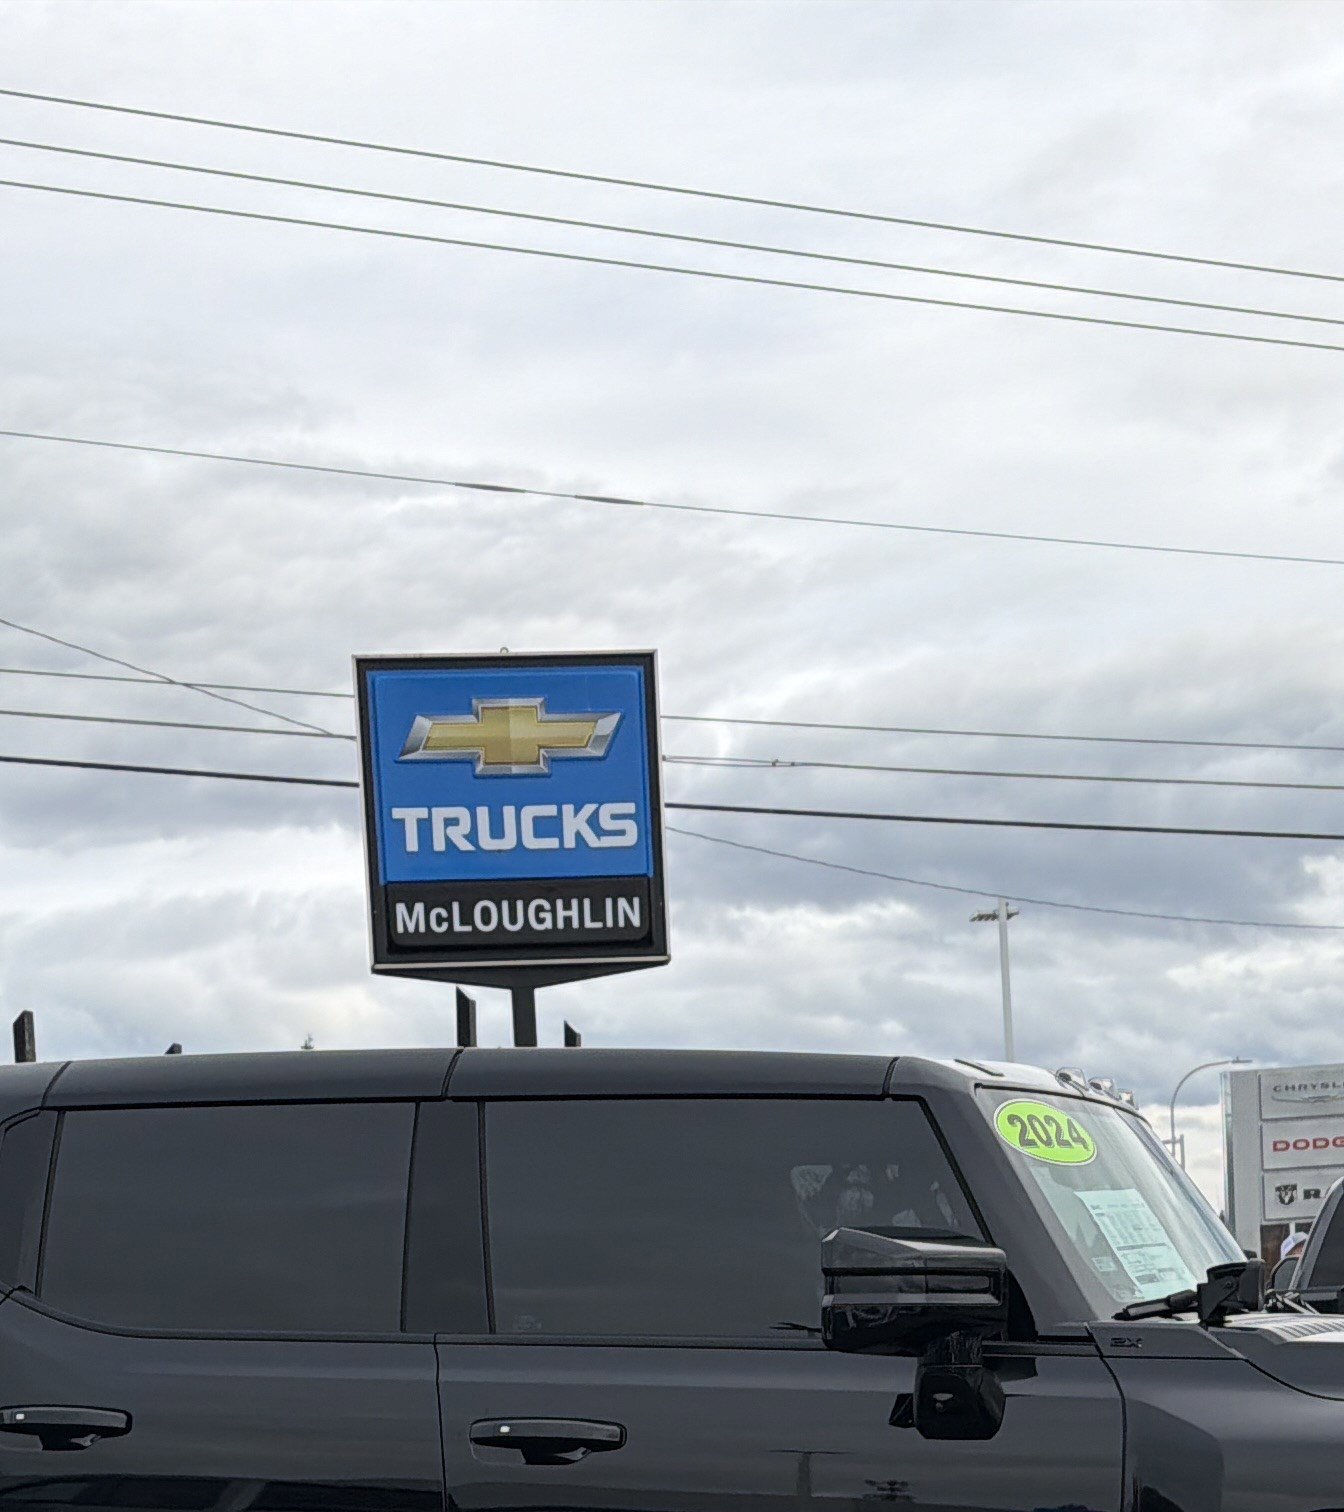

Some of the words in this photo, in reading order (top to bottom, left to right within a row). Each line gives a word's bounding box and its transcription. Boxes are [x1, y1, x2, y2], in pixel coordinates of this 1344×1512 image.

[391, 802, 639, 852] TRUCKS
[395, 896, 642, 934] McLOUGHLIN
[1006, 1113, 1091, 1152] 2024
